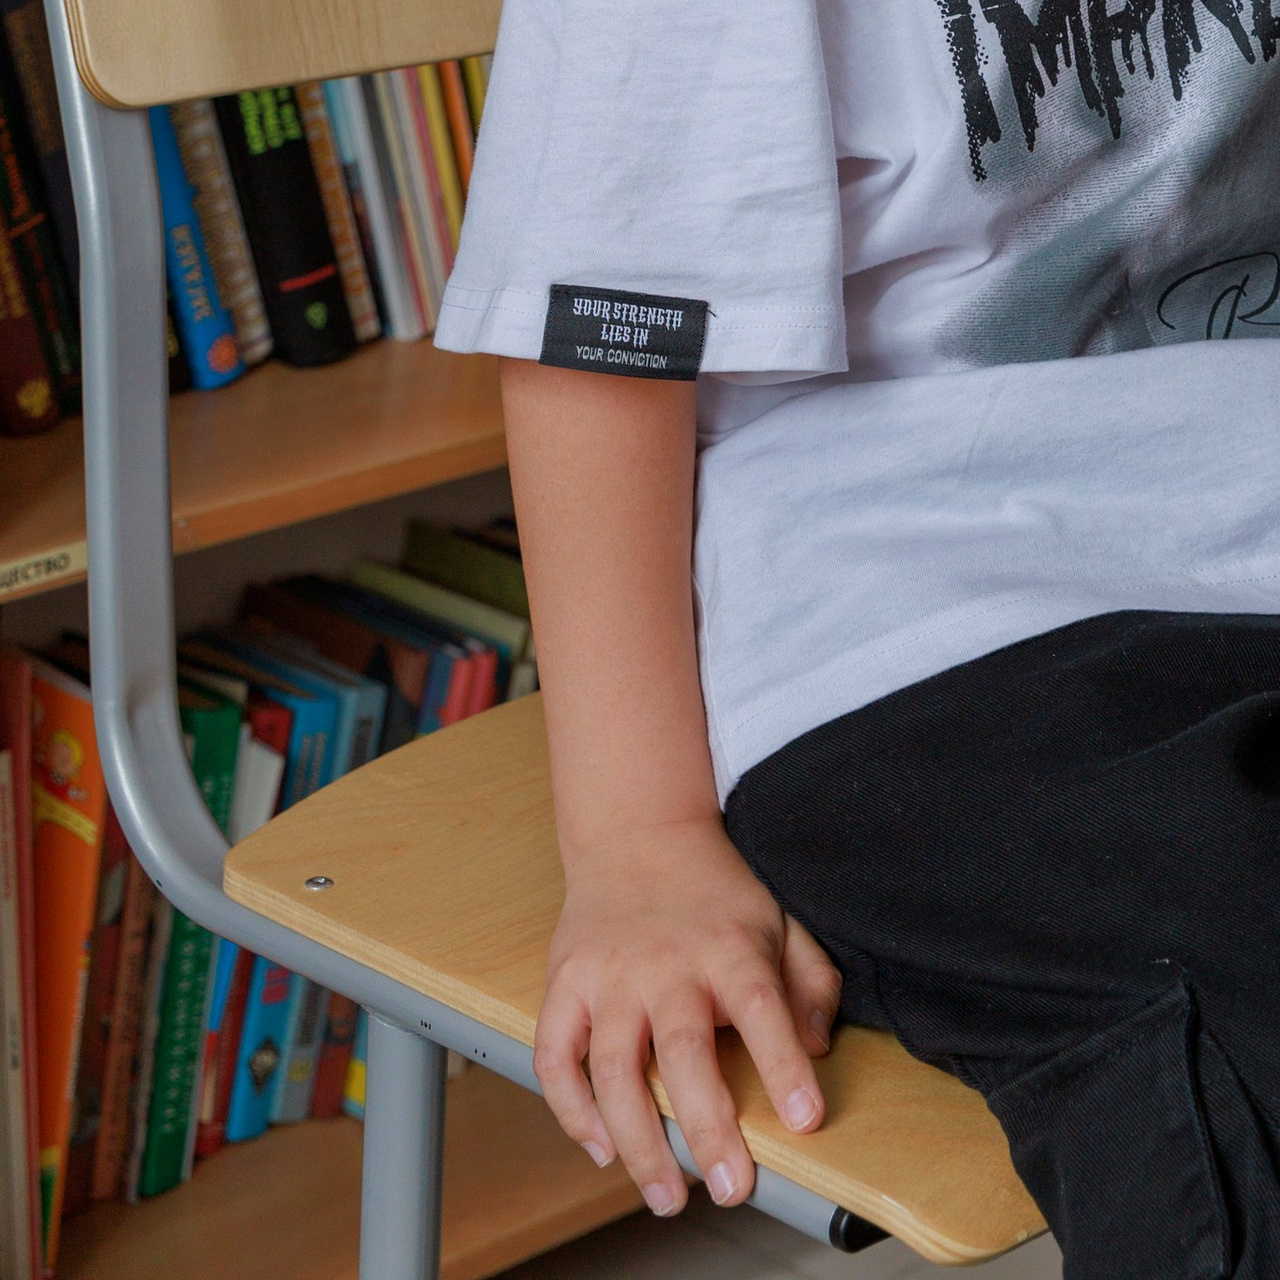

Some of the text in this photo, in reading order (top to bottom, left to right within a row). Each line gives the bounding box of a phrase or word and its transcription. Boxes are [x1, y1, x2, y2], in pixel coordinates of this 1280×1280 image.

[573, 297, 684, 332] YOUR STRENGTH
[600, 323, 650, 349] LIES IN
[576, 345, 668, 369] YOUR CONVICTION
